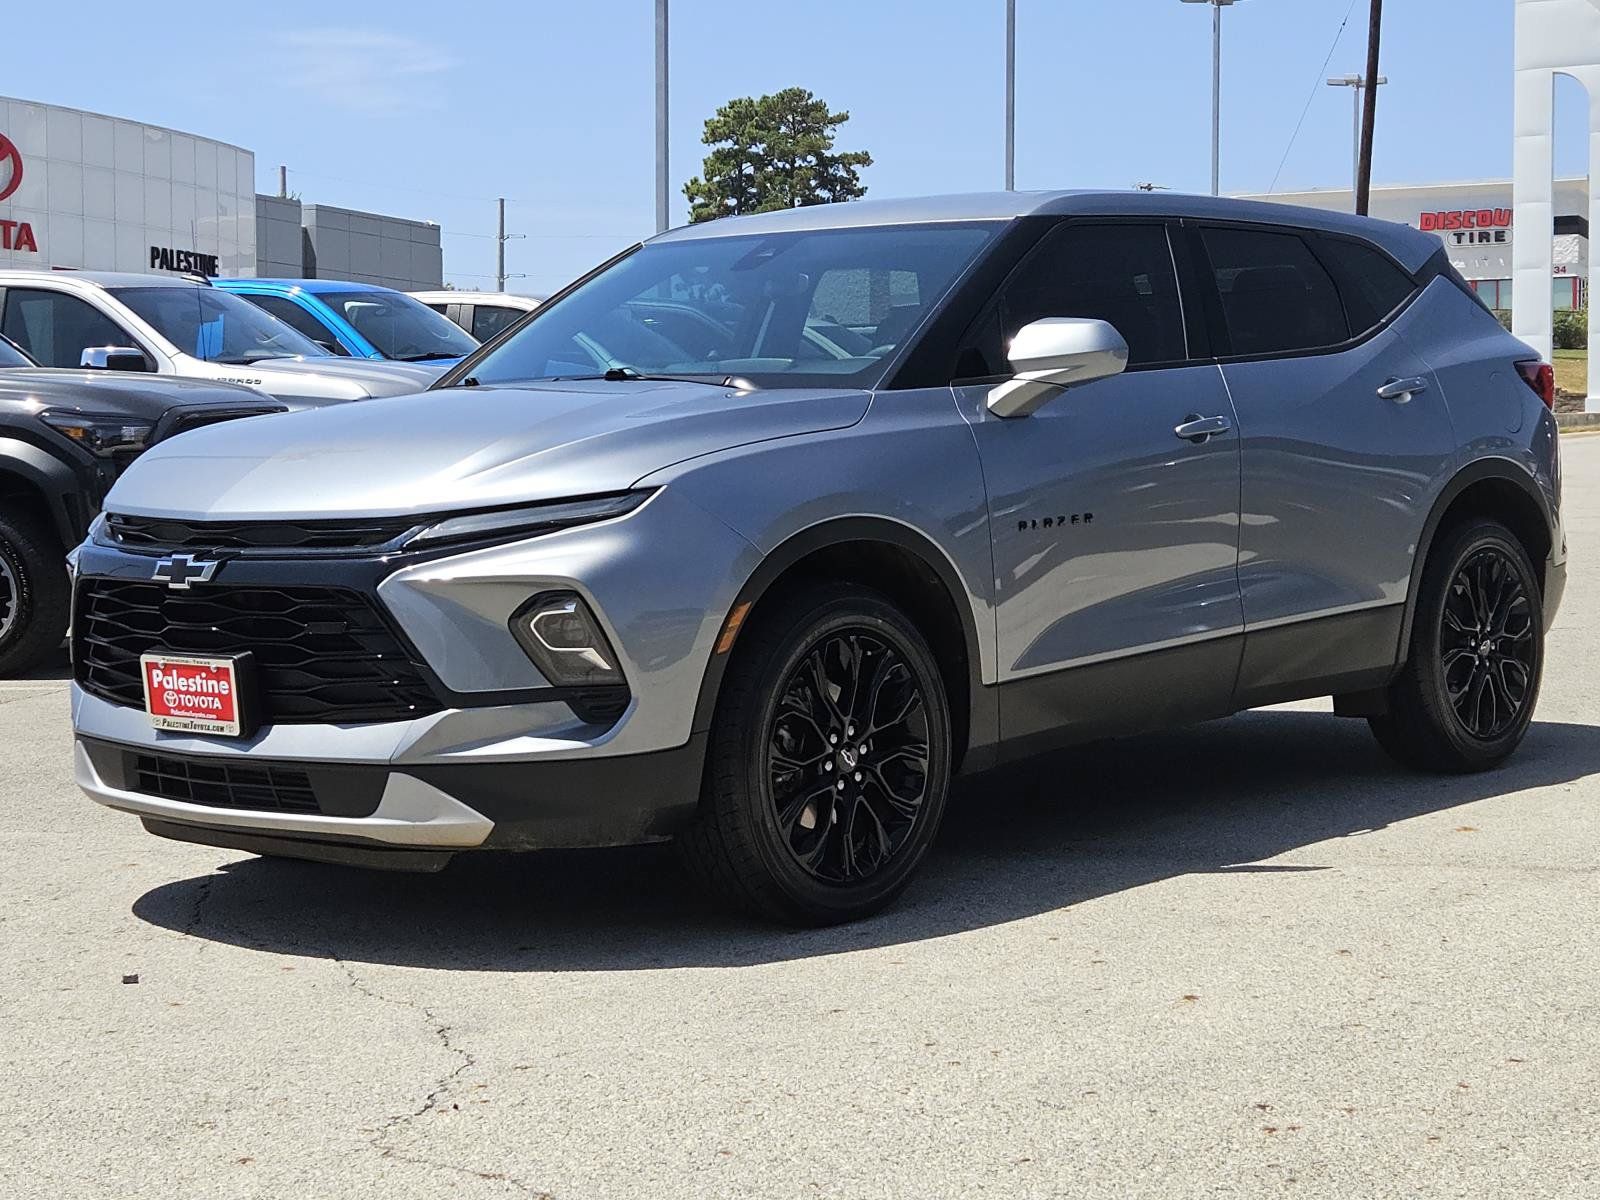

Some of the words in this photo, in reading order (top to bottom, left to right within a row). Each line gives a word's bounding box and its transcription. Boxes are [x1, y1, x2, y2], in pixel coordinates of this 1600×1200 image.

[1420, 208, 1513, 231] DISCOU
[1453, 230, 1506, 244] TIRE
[150, 246, 219, 277] PALESTINE
[1553, 266, 1567, 274] 34
[152, 669, 230, 695] Palestine
[178, 694, 222, 710] TOYOTA
